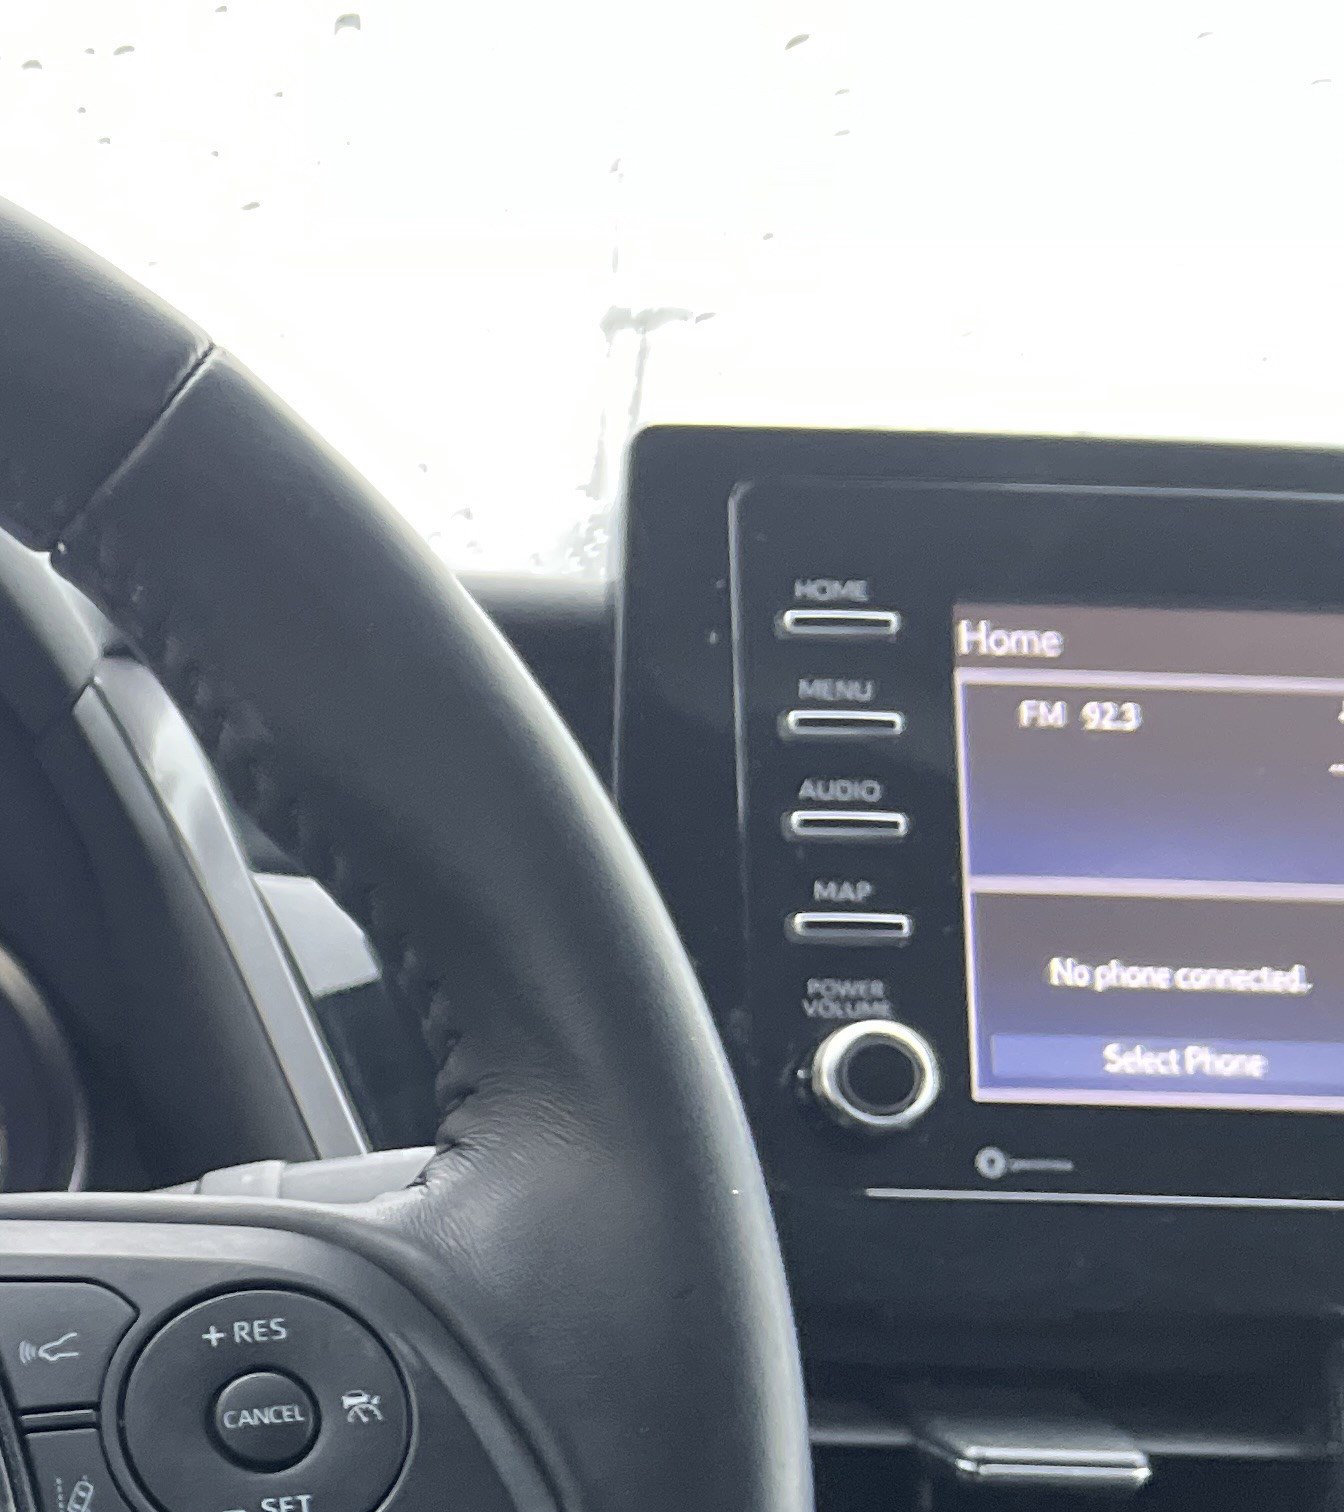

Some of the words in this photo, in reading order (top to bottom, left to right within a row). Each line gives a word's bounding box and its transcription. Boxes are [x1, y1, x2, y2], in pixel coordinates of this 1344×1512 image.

[794, 579, 869, 601] HOME
[957, 618, 1064, 658] Home
[798, 678, 874, 702] MENU
[1018, 700, 1068, 730] FM
[1081, 701, 1144, 731] 92.3
[799, 778, 883, 803] AUDIO
[813, 879, 873, 902] MAP
[1048, 957, 1091, 988] No
[1093, 962, 1171, 994] phone
[807, 978, 885, 999] POWER
[802, 998, 893, 1019] VOLUME
[1101, 1042, 1180, 1076] Select
[1185, 1043, 1269, 1080] Phone
[233, 1317, 288, 1344] RES
[223, 1404, 305, 1429] CANCEL
